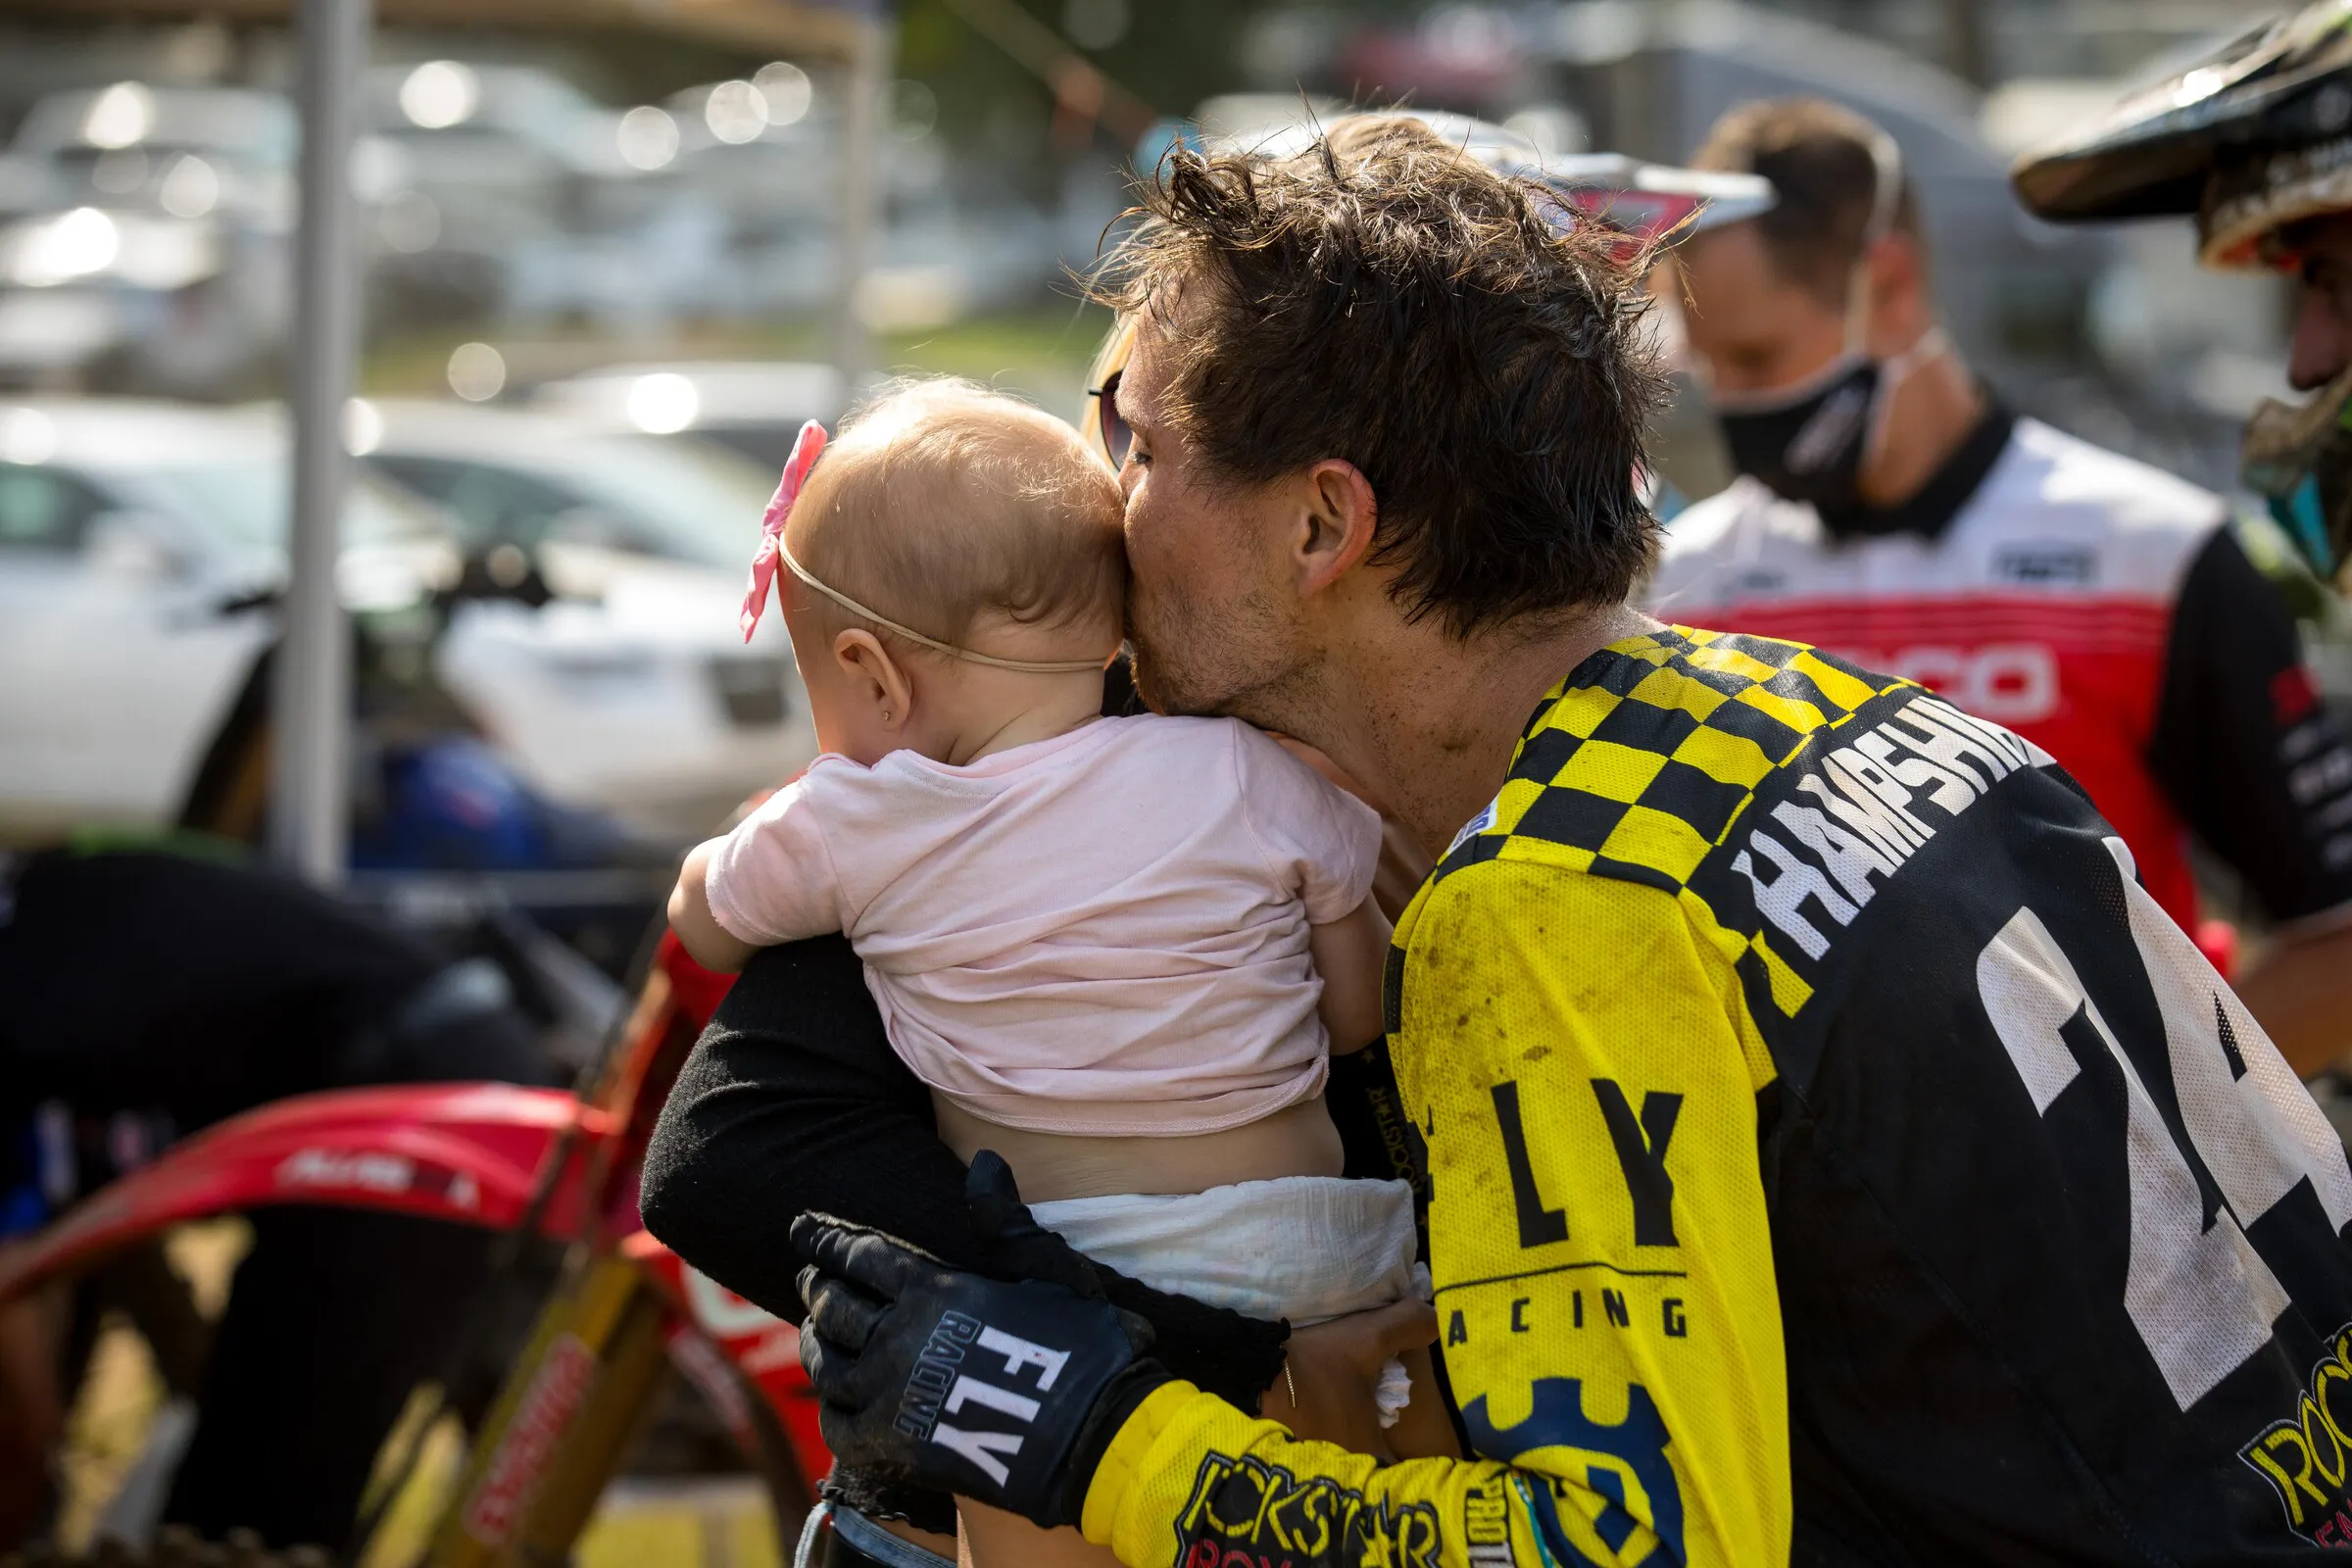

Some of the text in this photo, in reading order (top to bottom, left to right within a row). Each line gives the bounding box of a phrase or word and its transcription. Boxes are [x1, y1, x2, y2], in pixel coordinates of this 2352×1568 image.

[1426, 1078, 1684, 1249] LY
[1977, 836, 2352, 1413] 24
[893, 1309, 981, 1442] RACING
[931, 1325, 1072, 1489] FLY
